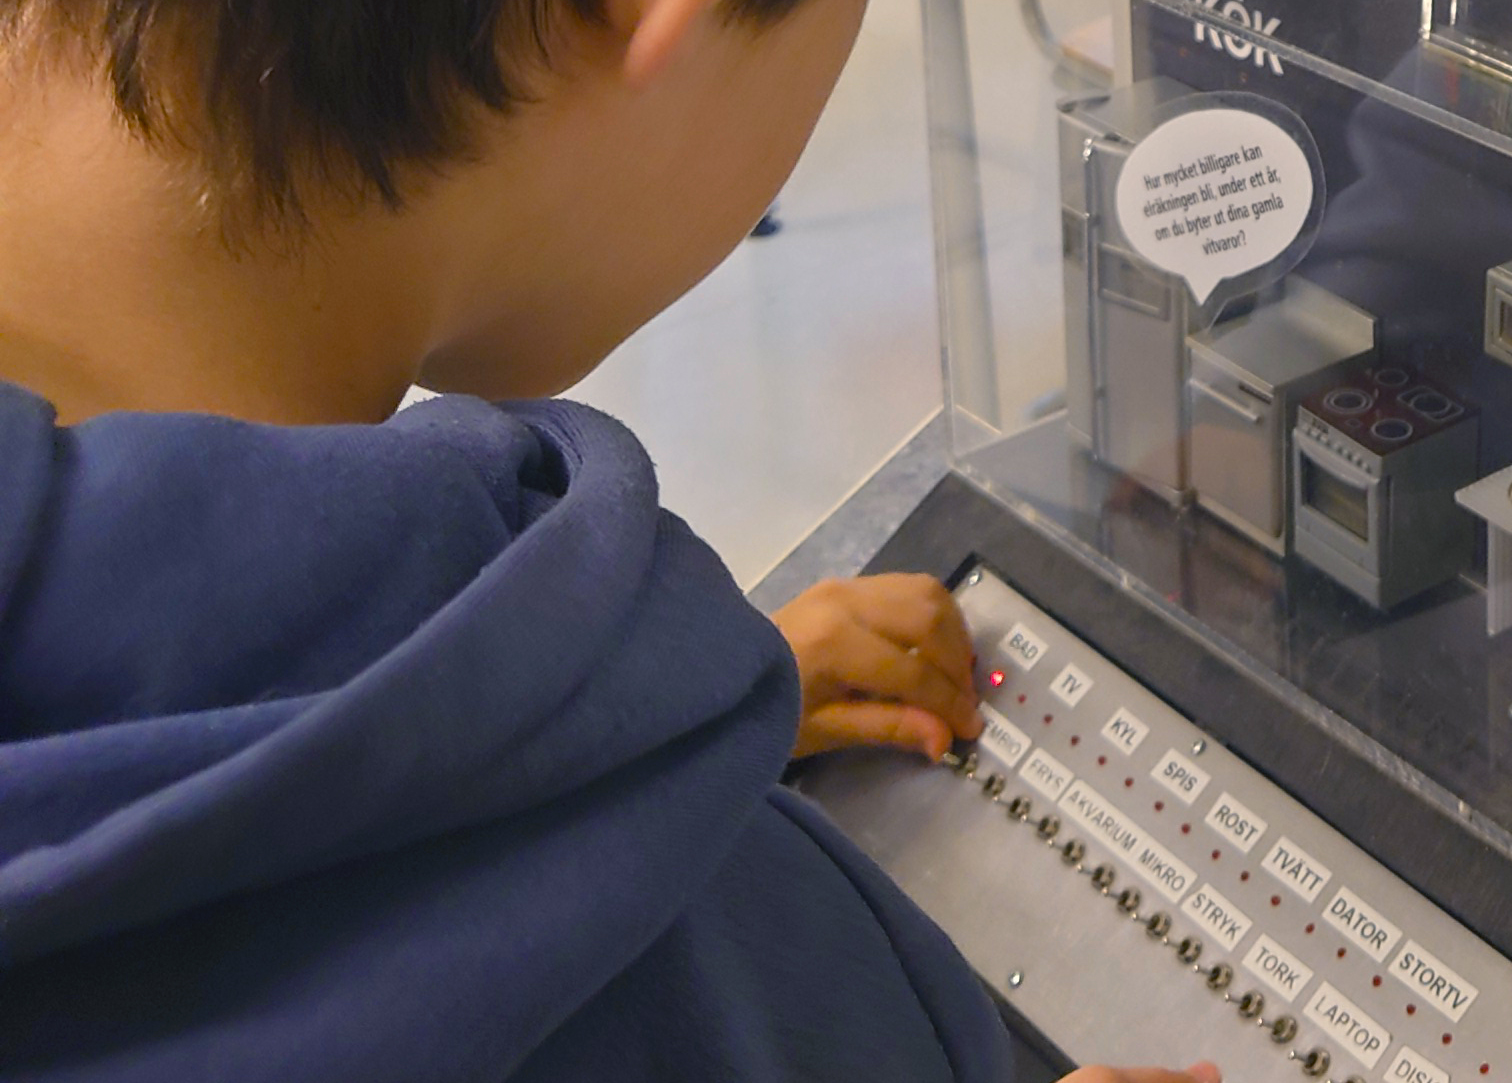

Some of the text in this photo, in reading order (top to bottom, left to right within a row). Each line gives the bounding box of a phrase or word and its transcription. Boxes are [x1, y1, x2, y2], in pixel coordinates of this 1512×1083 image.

[1144, 145, 1263, 191] Hur mycket billigare kan
[1143, 165, 1282, 218] elräkningen bli, under ett år,
[1154, 193, 1284, 241] om du byter ut dina gamla
[1202, 229, 1247, 255] vitvaror?
[1009, 633, 1039, 660] BAD
[1061, 673, 1082, 695] TV
[1110, 717, 1137, 747] KYL
[1030, 758, 1064, 789] FRYS
[1163, 760, 1199, 792] SPIS
[1067, 788, 1138, 852] AKVARIUM
[1214, 804, 1259, 842] ROST
[1138, 849, 1187, 892] MIKRO
[1270, 846, 1324, 893] TVÄTT
[1192, 892, 1243, 940] STRYK
[1329, 897, 1389, 951] DATOR
[1255, 946, 1301, 990] TORK
[1399, 952, 1470, 1010] STORTV
[1313, 995, 1381, 1053] LAPTOP
[1394, 1059, 1434, 1083] DIS
